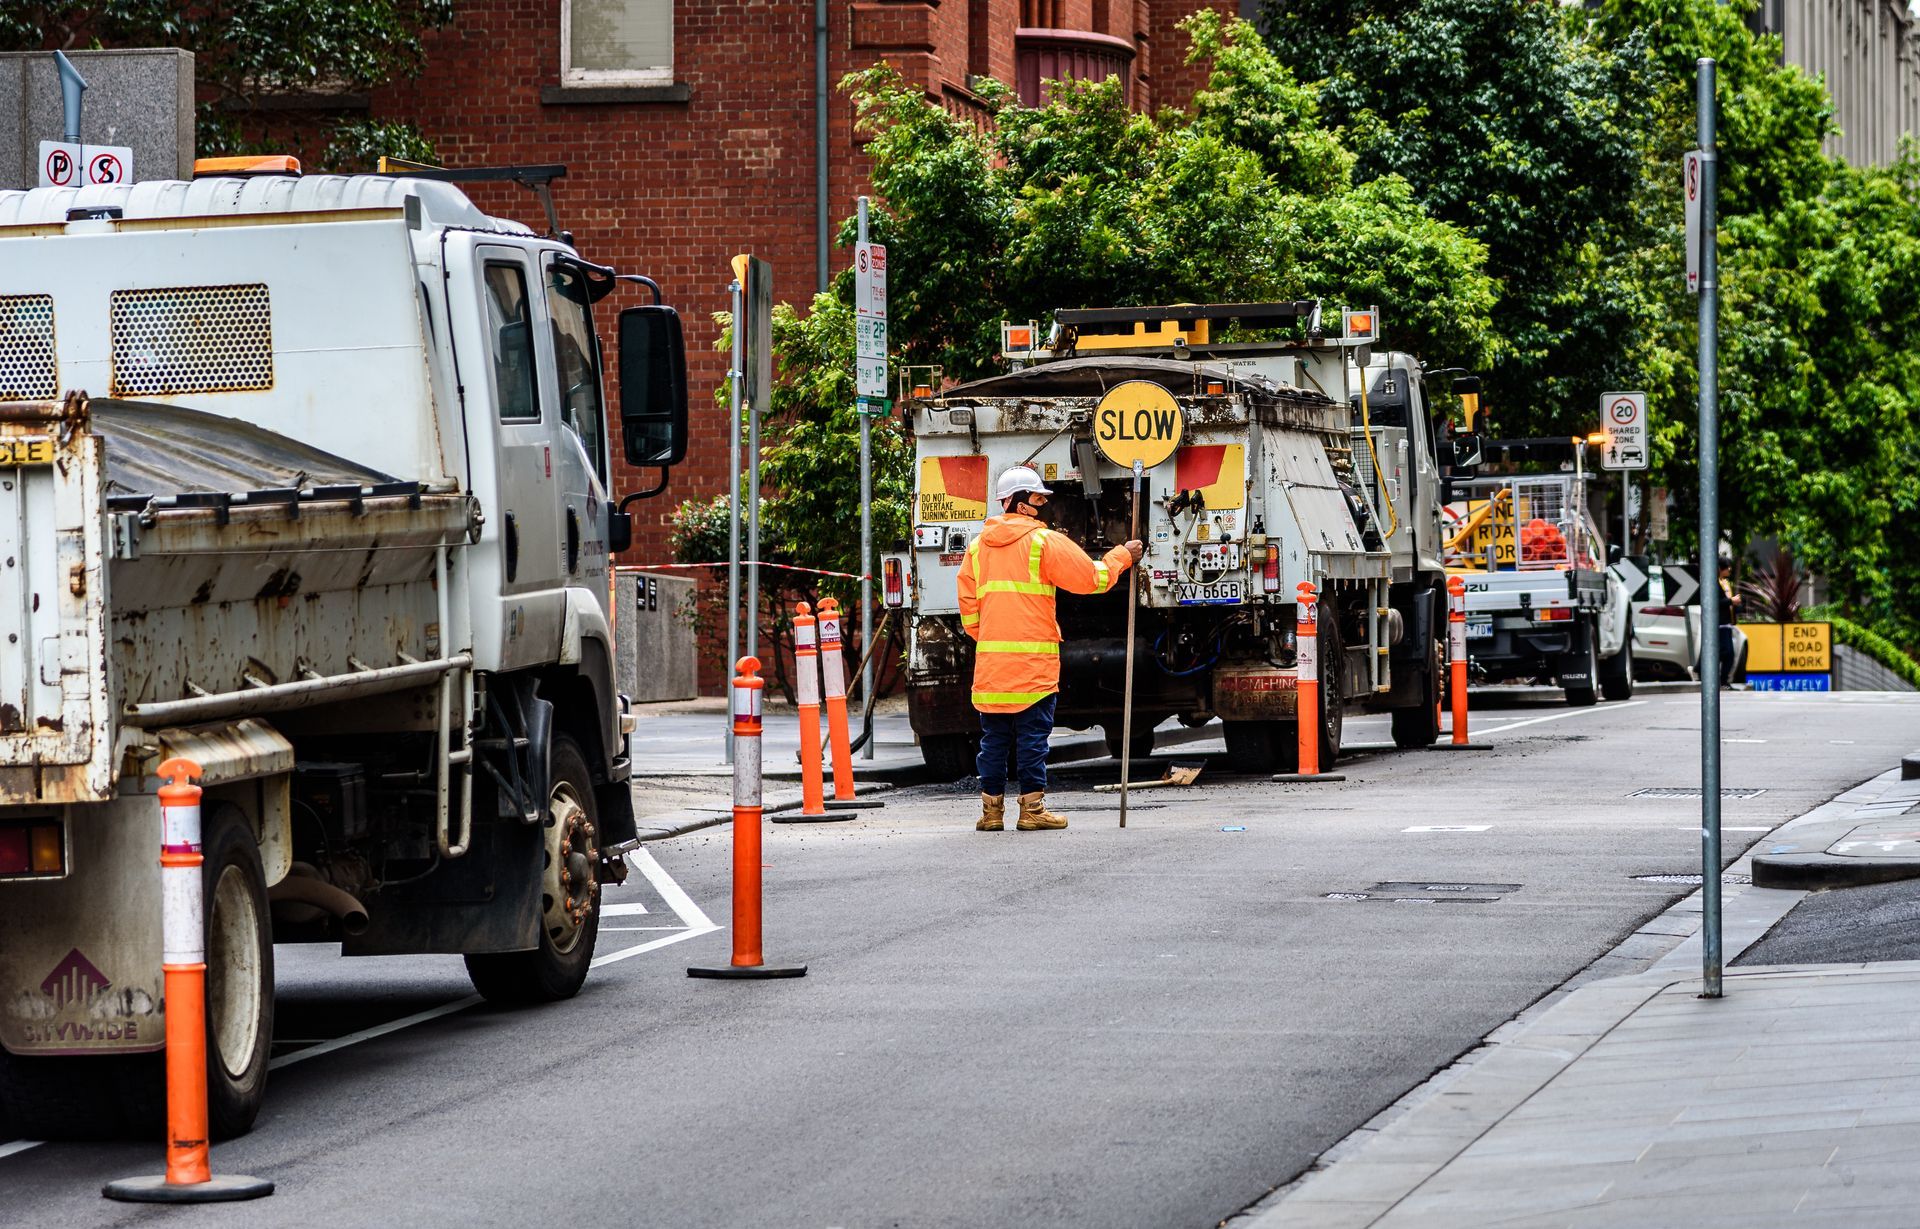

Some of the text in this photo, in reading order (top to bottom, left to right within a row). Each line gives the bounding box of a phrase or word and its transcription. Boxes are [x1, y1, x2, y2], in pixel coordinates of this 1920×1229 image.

[873, 321, 885, 339] 2P
[875, 366, 884, 383] 1P
[1616, 406, 1633, 417] 20
[1100, 410, 1176, 440] SLOW
[921, 493, 946, 502] DO NOT
[921, 502, 954, 511] OVERTAKE
[922, 510, 976, 520] TURNING VEHICLE
[1479, 526, 1514, 539] ROA
[1480, 545, 1515, 560] WOR
[1465, 584, 1489, 592] UZU
[1793, 627, 1817, 638] END
[1789, 641, 1822, 652] ROAD
[1789, 657, 1822, 667] WORK
[1780, 679, 1822, 690] SAFELY
